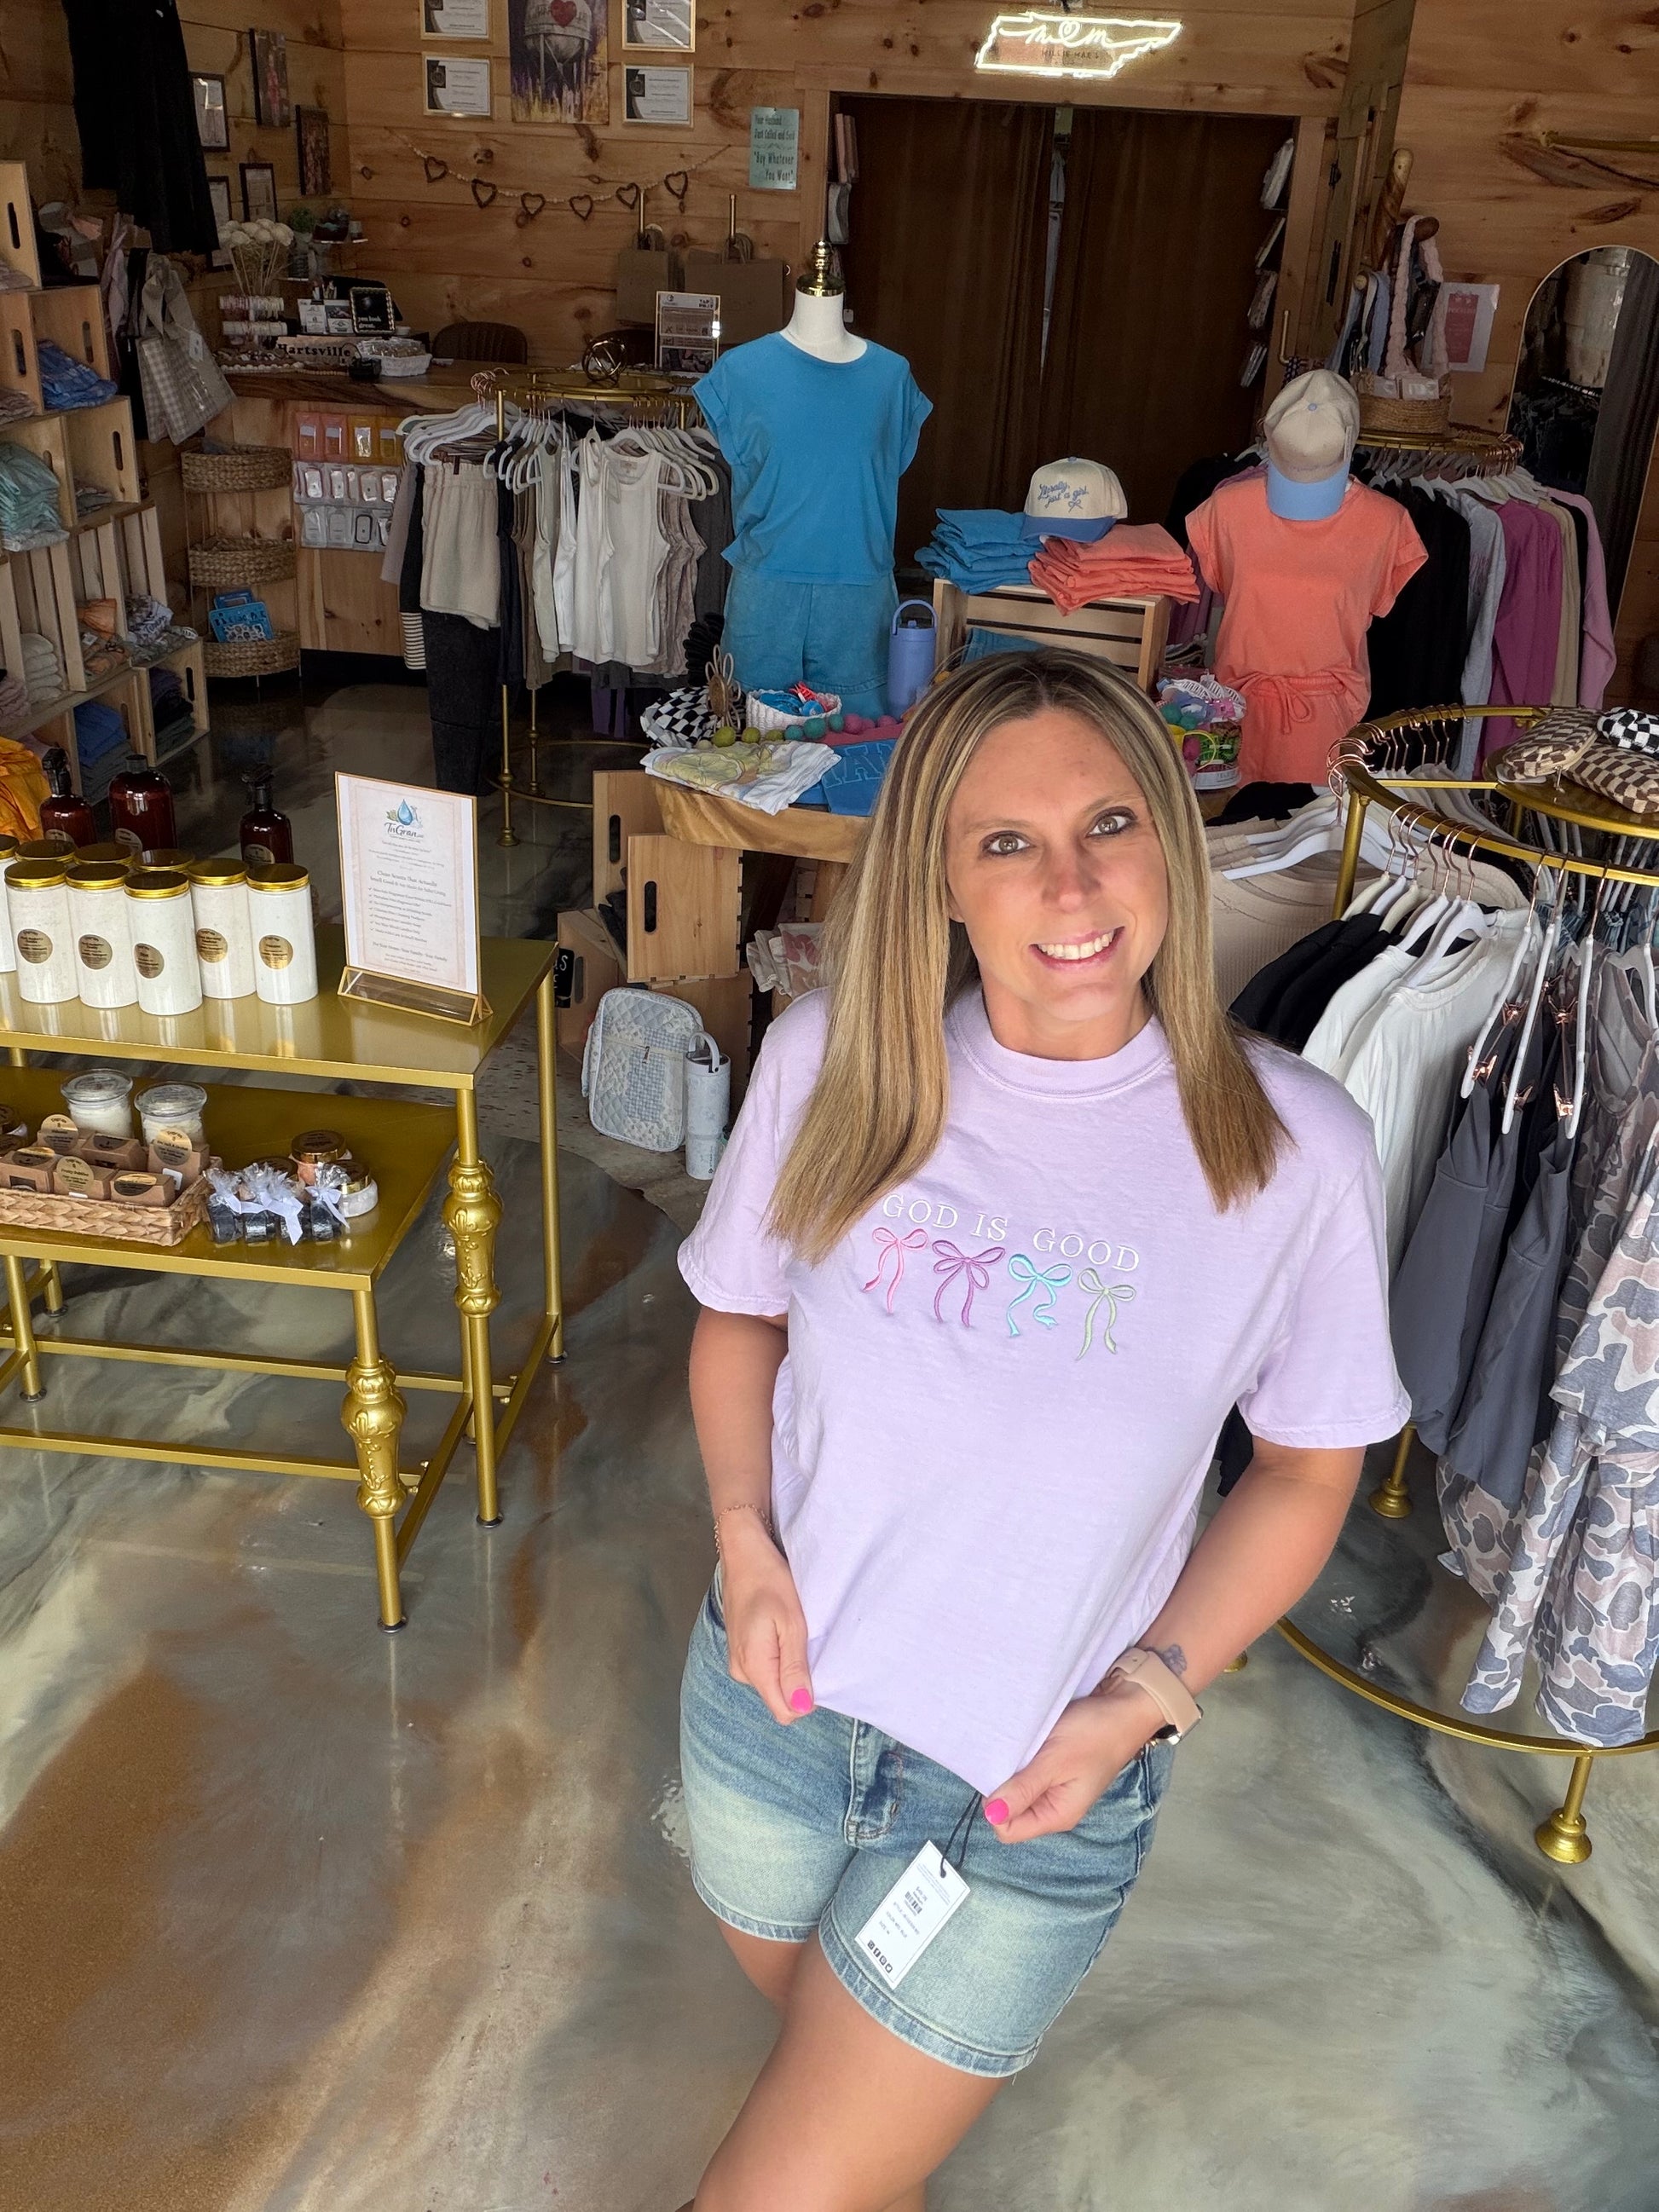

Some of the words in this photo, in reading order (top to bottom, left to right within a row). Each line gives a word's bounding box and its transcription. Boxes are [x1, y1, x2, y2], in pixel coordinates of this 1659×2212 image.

[767, 152, 795, 165] Whatever
[765, 169, 775, 182] You
[277, 343, 351, 358] Hartsville
[882, 1193, 959, 1229] GOD
[970, 1213, 1009, 1242] IS
[1032, 1227, 1140, 1272] GOOD
